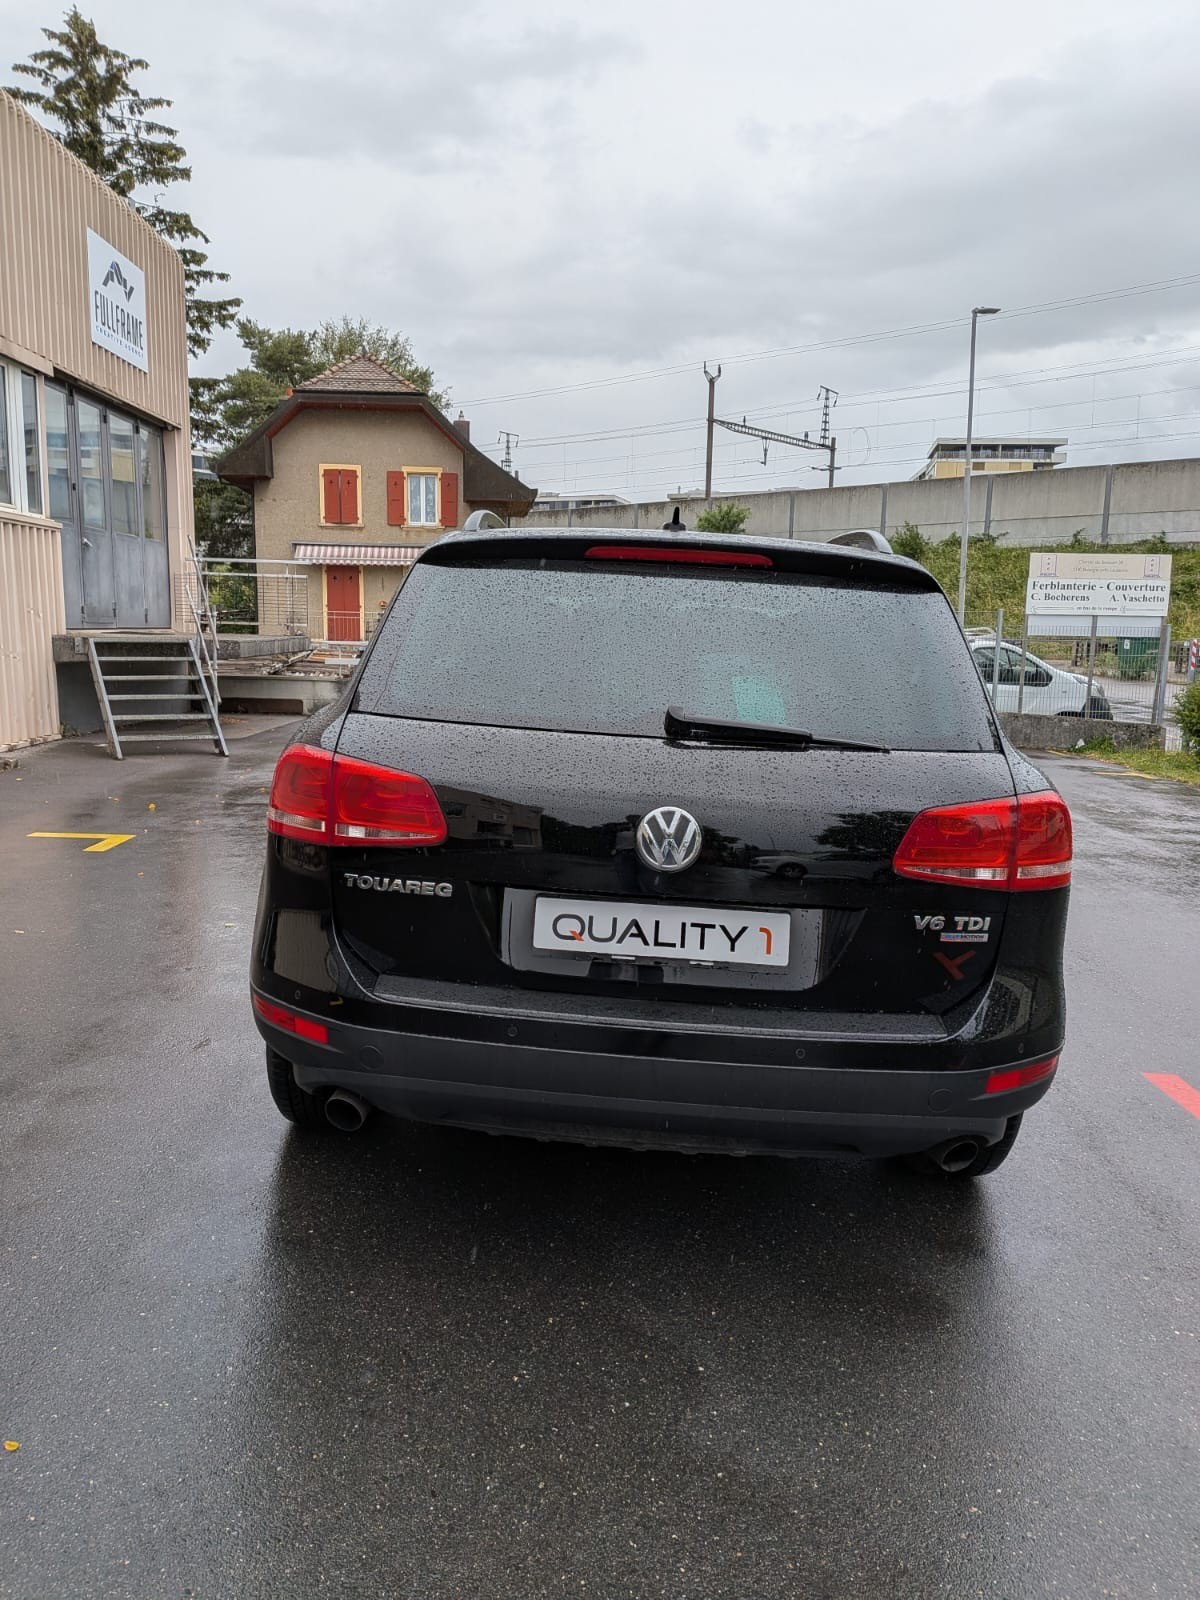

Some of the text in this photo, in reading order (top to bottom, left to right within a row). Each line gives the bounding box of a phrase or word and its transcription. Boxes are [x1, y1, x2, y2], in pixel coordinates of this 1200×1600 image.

[94, 290, 143, 350] FULLFRAME
[1032, 580, 1097, 591] Ferblanterie
[1106, 581, 1167, 592] Couverture
[1031, 592, 1091, 602] C. Bocherens
[1109, 593, 1166, 603] A. Vaschetto
[343, 873, 453, 897] TOUAREG
[914, 915, 992, 931] V6 TDI
[552, 913, 749, 952] QUALITY
